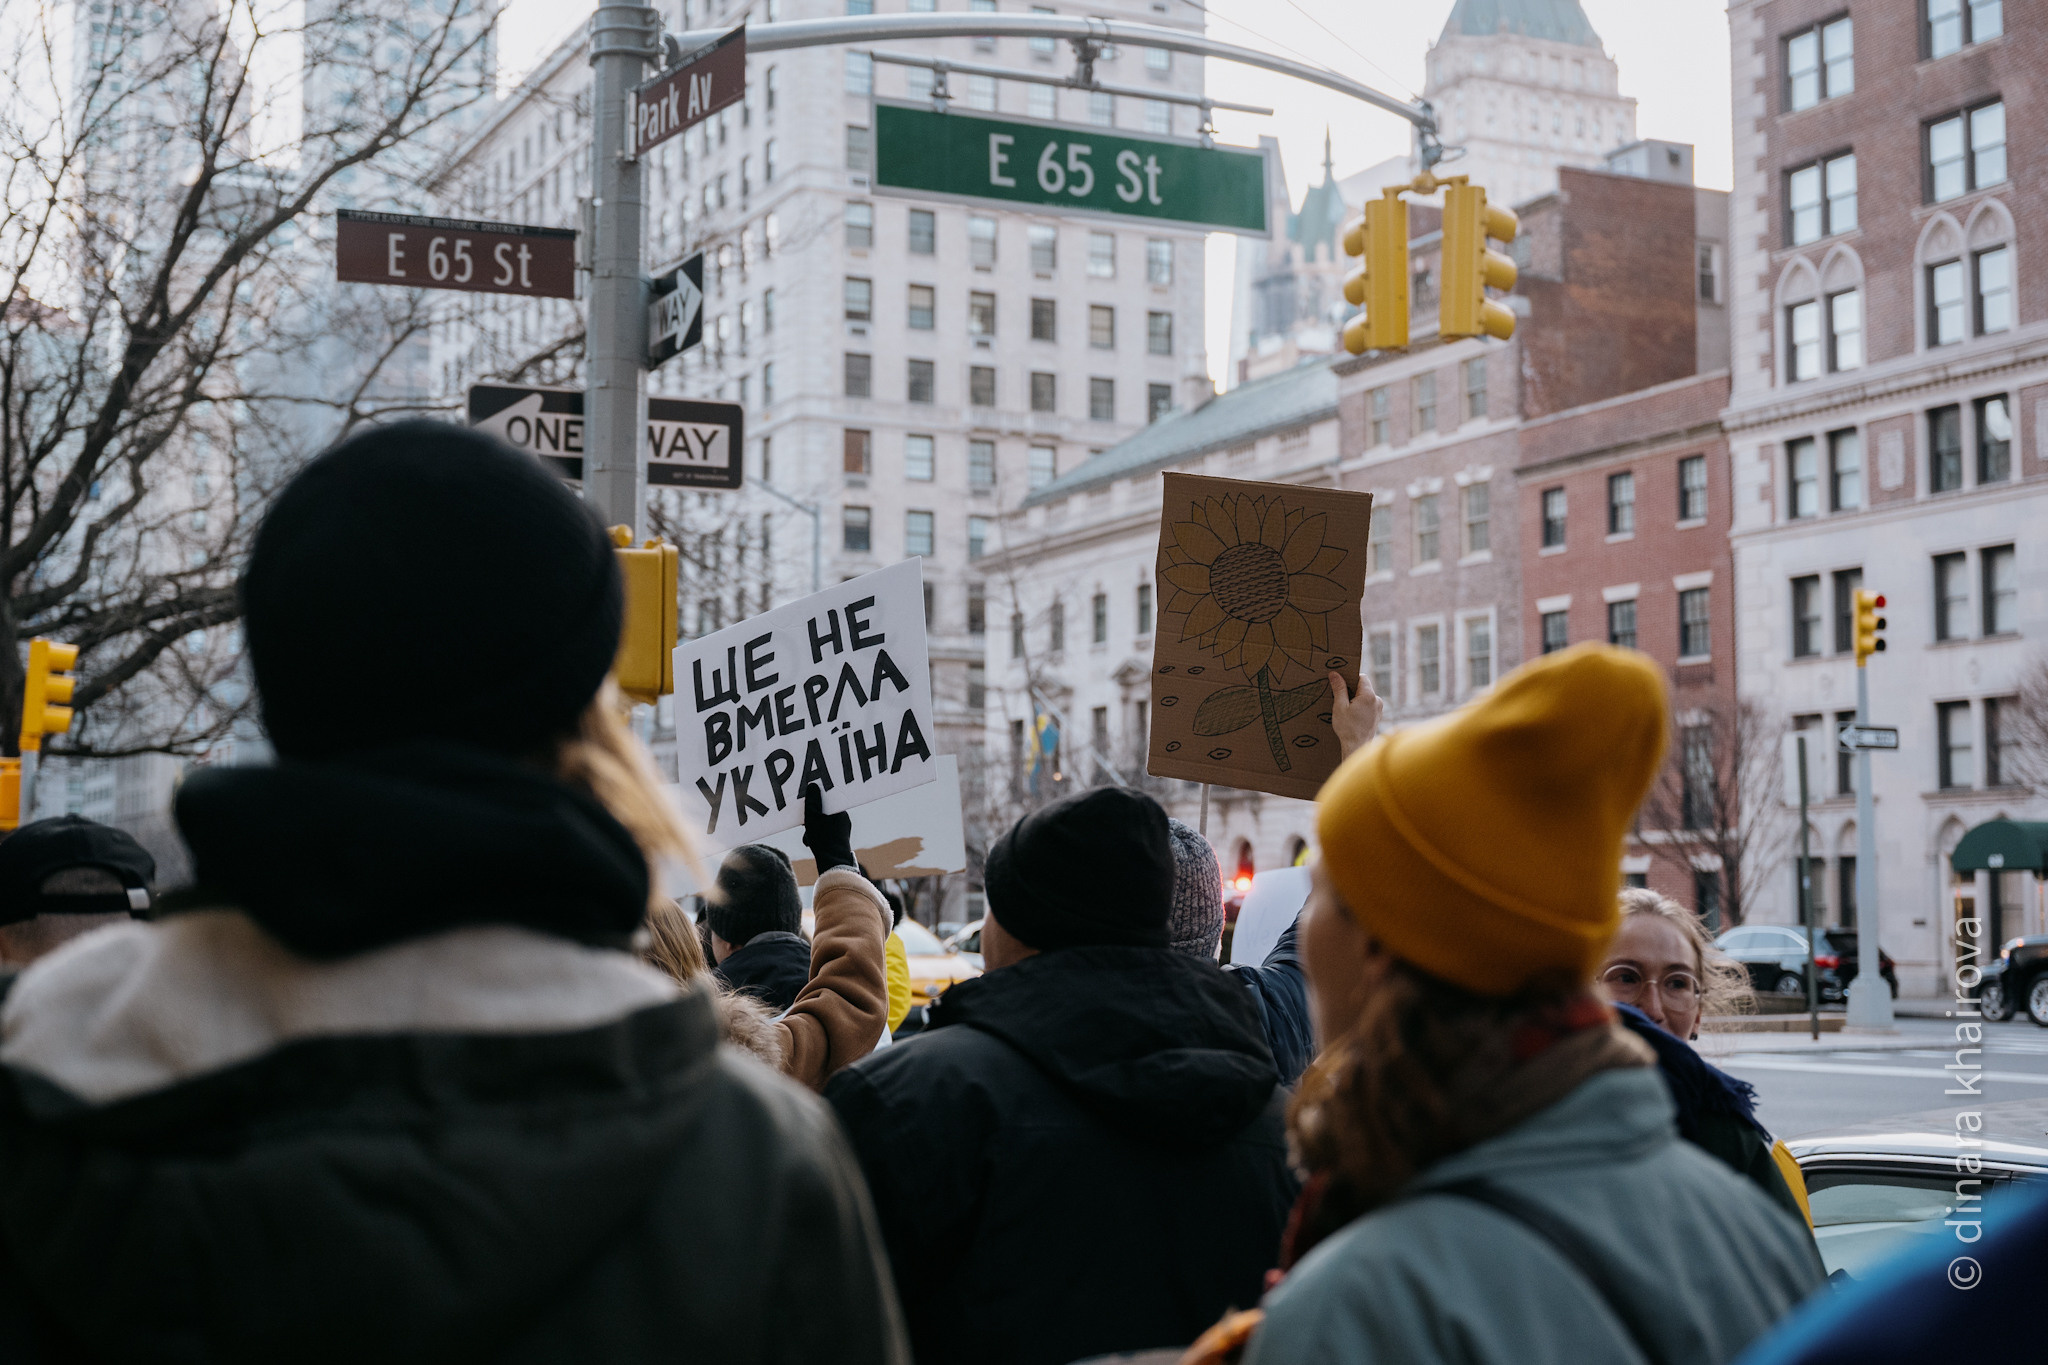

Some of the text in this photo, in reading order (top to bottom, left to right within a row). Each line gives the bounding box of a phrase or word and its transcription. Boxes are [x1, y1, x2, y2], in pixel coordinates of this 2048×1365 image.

[638, 72, 713, 148] Park Av
[988, 132, 1163, 206] E 65 St
[388, 233, 533, 288] E 65 St
[659, 286, 691, 336] WAY
[506, 415, 720, 461] ONE WAY
[692, 595, 886, 713] ЩЕ НЕ
[704, 648, 910, 767] ВМЕРЛА
[695, 708, 932, 835] УКРАЇНА
